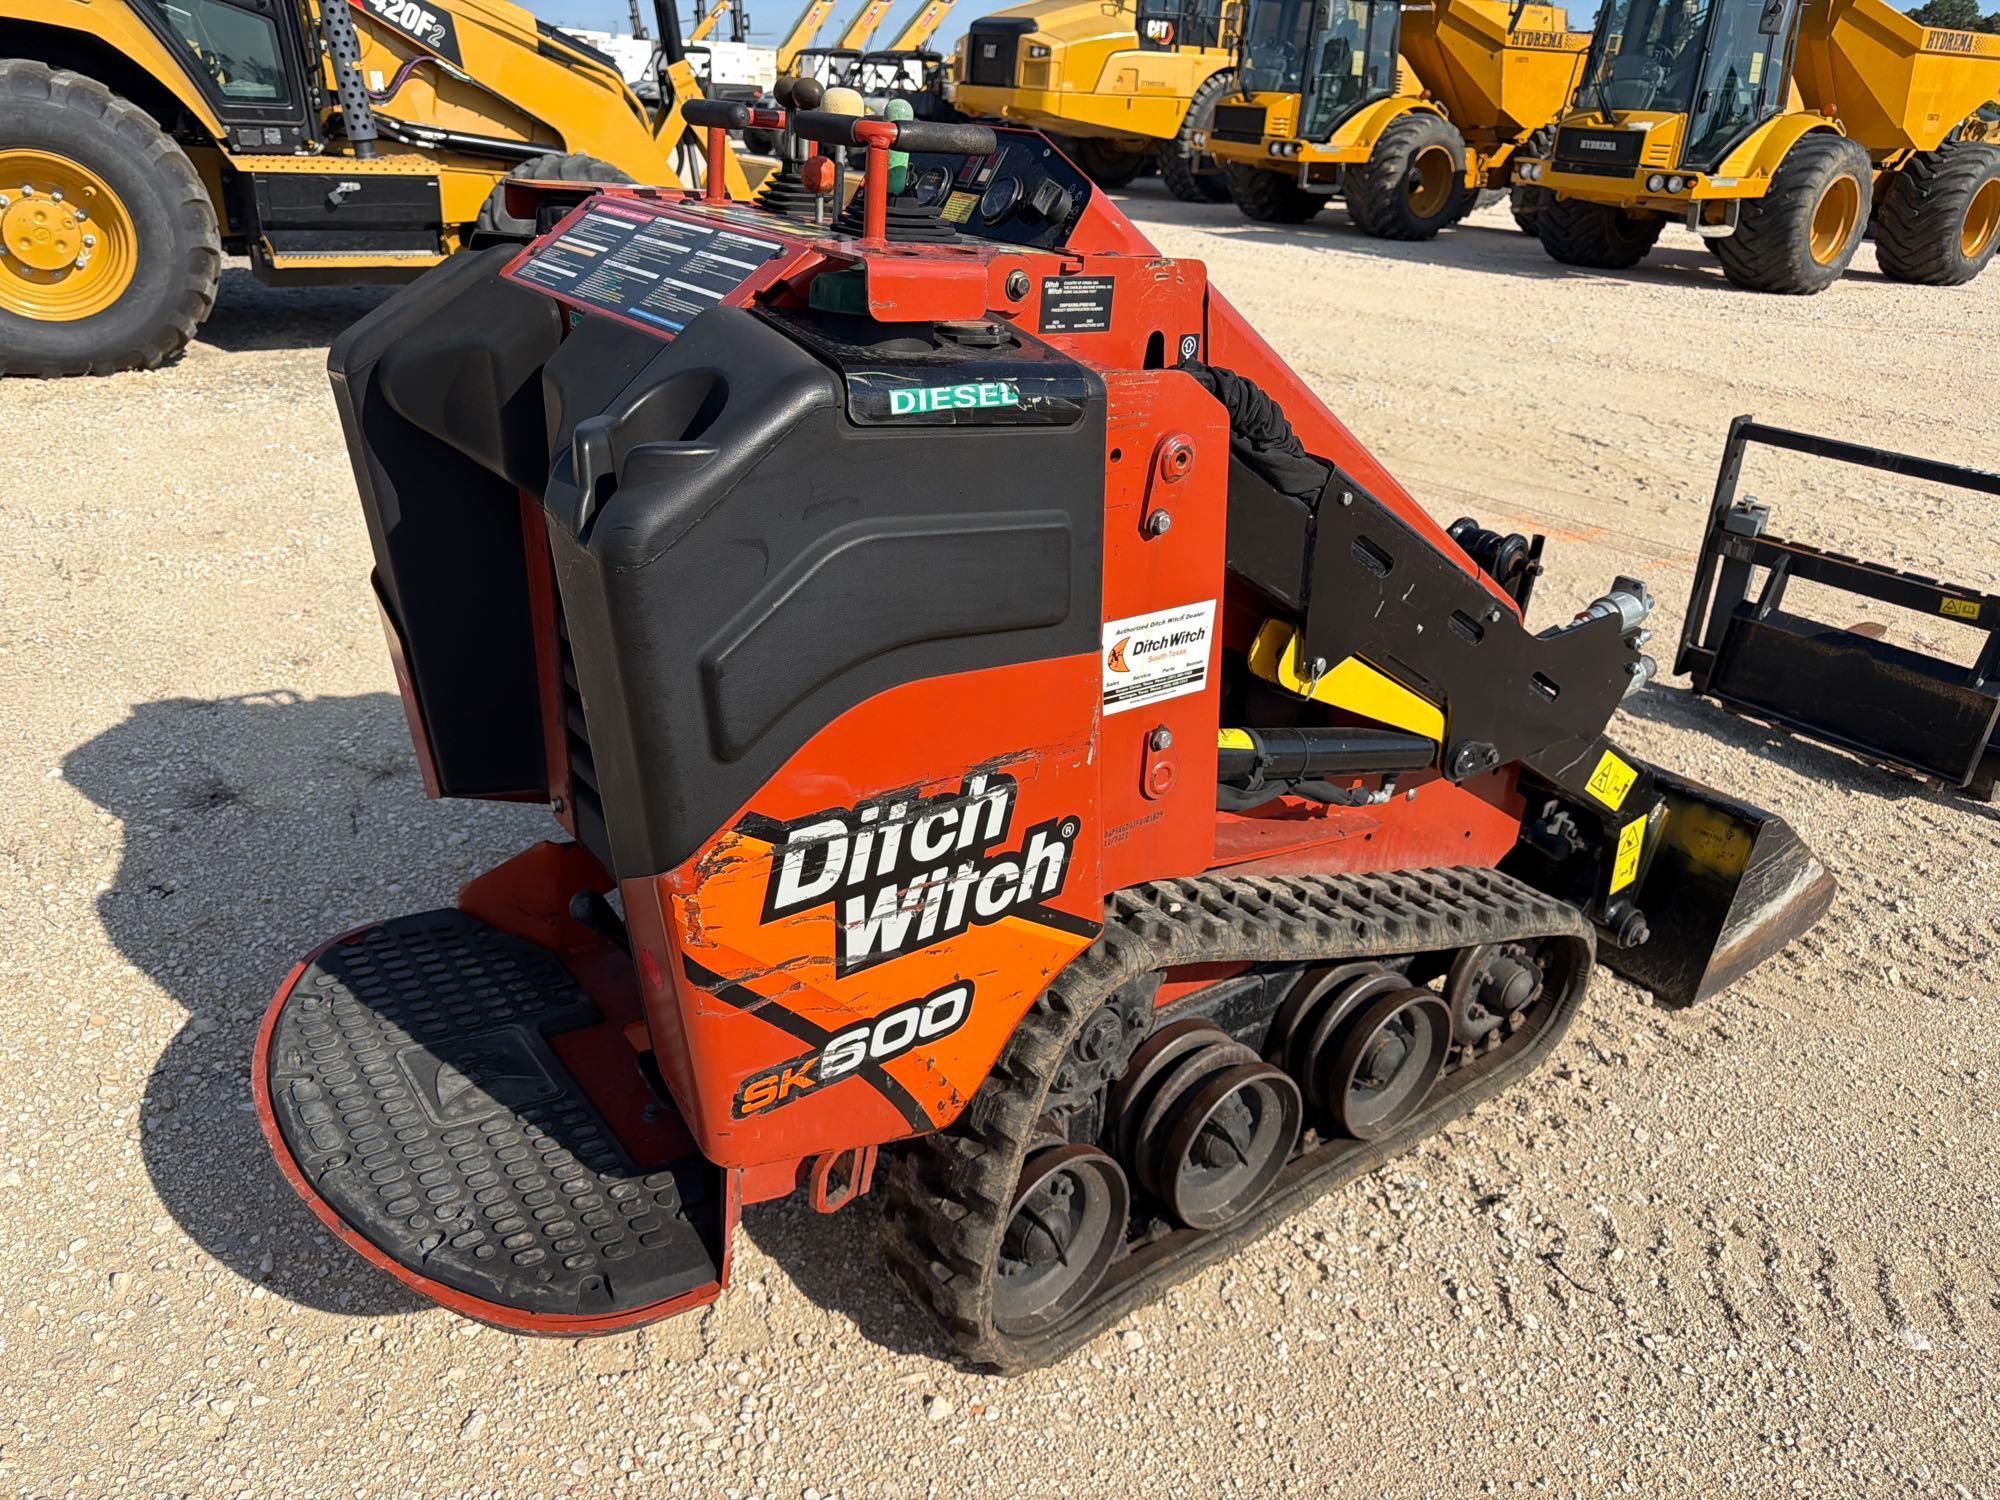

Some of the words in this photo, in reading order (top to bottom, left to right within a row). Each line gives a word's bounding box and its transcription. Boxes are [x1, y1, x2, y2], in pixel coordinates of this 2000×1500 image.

[1147, 20, 1169, 39] CAT
[1512, 31, 1563, 48] HYDREMA
[1926, 30, 1974, 53] HYDREMA
[891, 382, 1019, 414] DIESEL
[1115, 624, 1149, 635] Authorized
[1150, 619, 1166, 629] Ditch
[1186, 611, 1205, 621] Dealer
[1147, 652, 1168, 663] South
[1168, 648, 1187, 659] Texas
[1106, 680, 1120, 688] Sales
[1132, 672, 1152, 681] Service
[774, 774, 1010, 910] Ditch
[741, 987, 968, 1114] SK600
